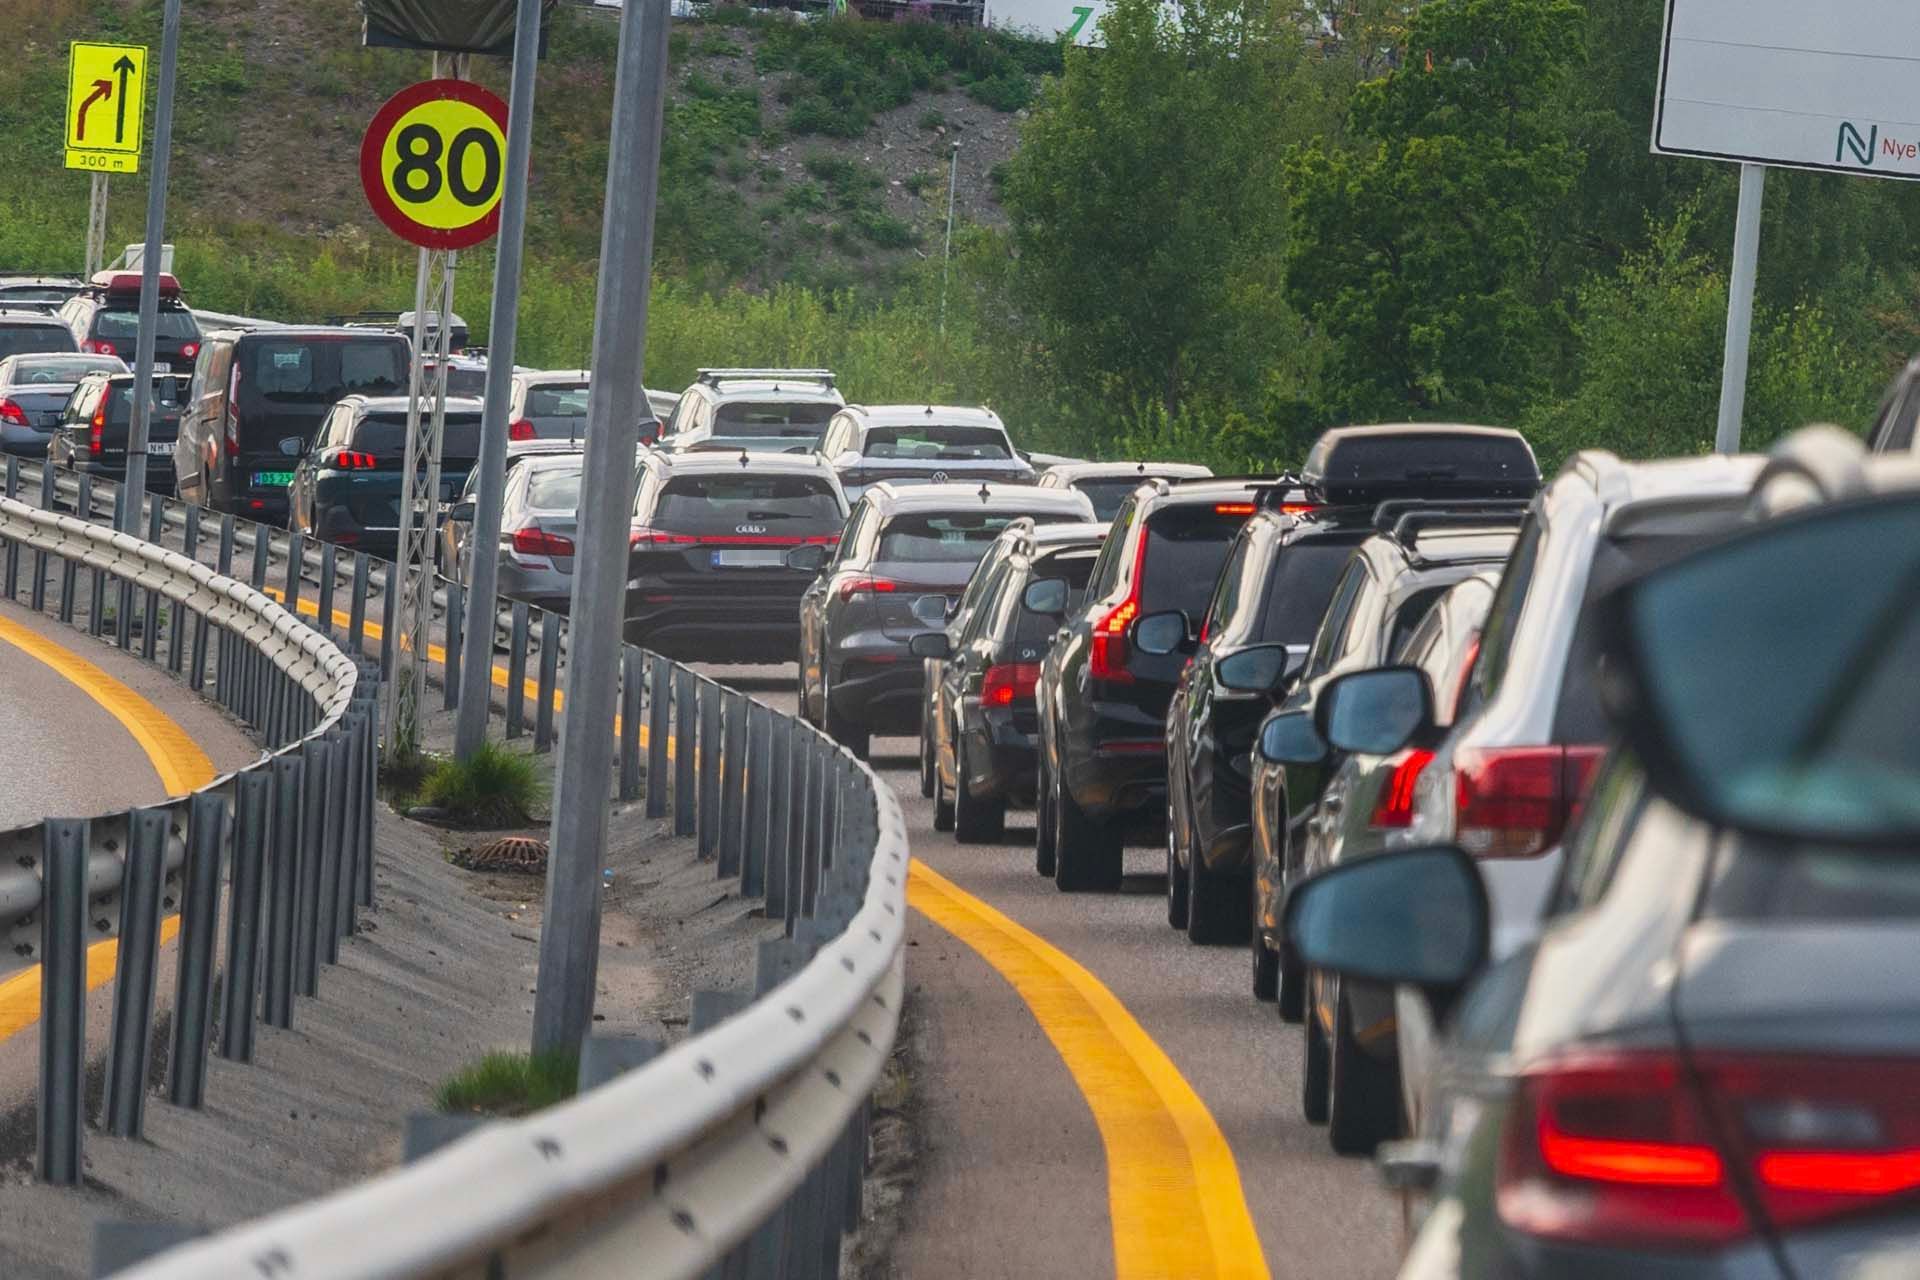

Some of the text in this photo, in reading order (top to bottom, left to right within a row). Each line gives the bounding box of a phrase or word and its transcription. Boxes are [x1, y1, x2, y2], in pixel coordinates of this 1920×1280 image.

[1883, 138, 1920, 160] Nye
[80, 155, 123, 168] 300 m
[392, 123, 500, 207] 80
